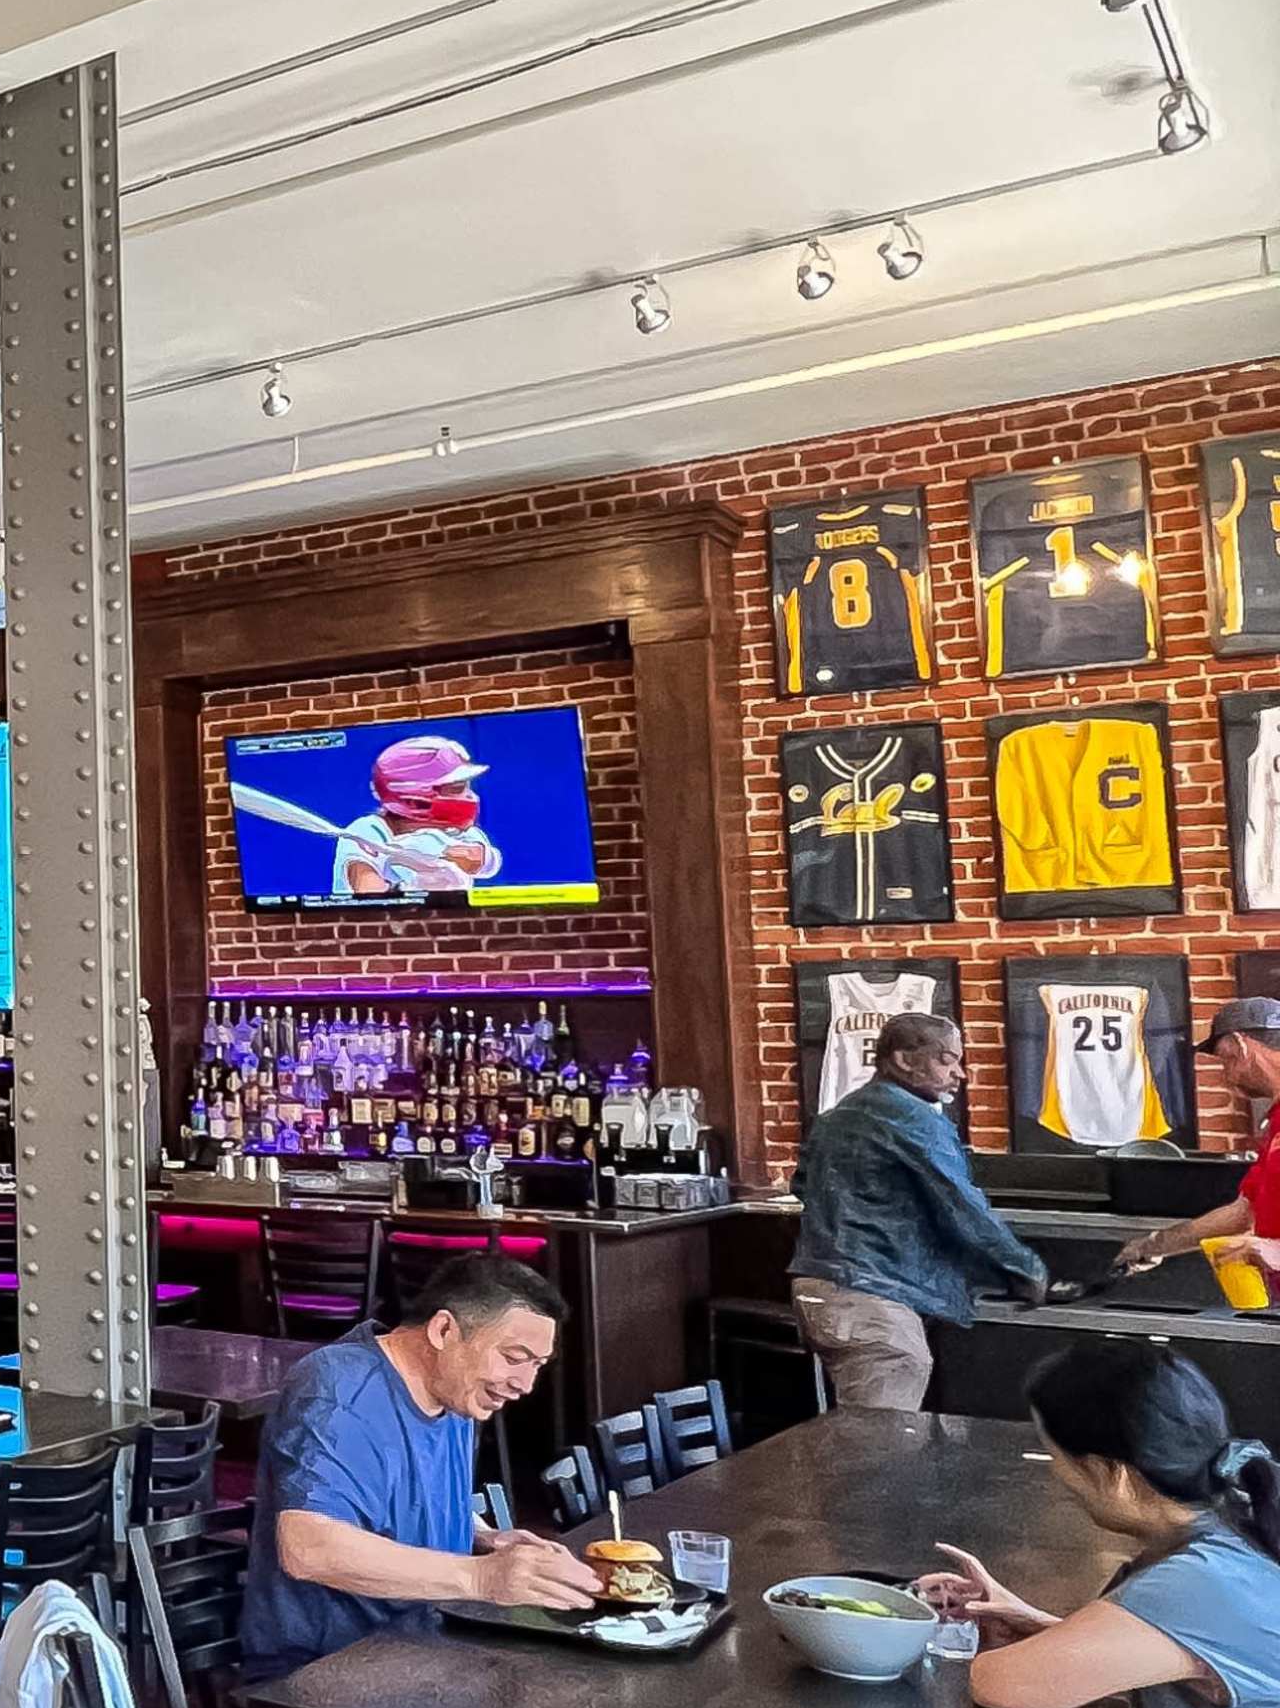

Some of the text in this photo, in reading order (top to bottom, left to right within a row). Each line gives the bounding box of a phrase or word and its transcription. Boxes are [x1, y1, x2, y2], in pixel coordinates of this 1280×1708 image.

[1044, 525, 1090, 599] 1
[829, 558, 873, 630] 8
[1098, 766, 1142, 810] C
[835, 1012, 893, 1035] CALIFO
[1058, 993, 1135, 1015] CALIFORNIA
[1072, 1014, 1123, 1052] 25
